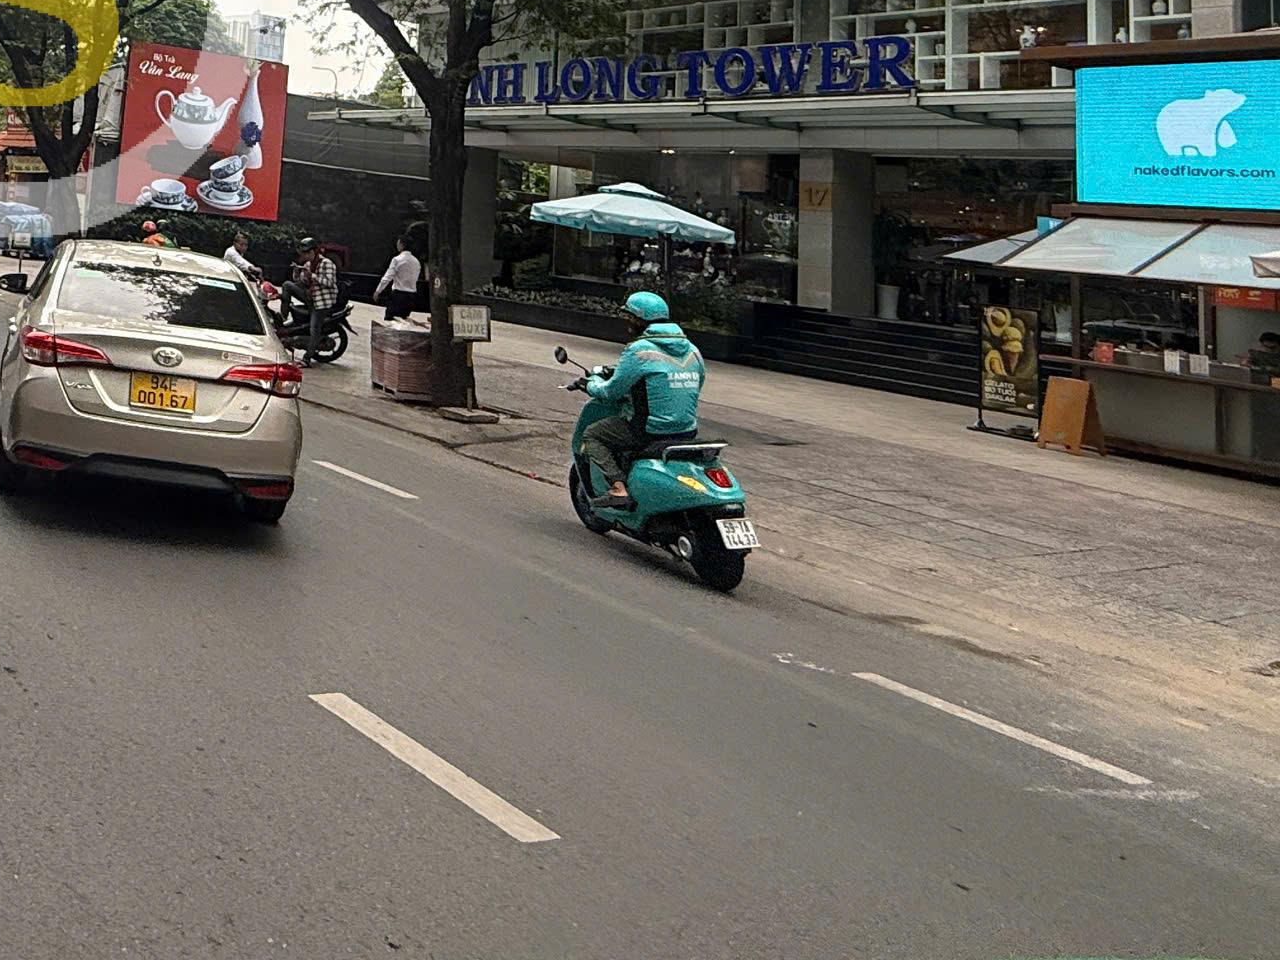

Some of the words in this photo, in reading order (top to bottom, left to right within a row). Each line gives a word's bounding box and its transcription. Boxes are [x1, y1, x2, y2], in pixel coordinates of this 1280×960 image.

[165, 65, 200, 84] Lang
[466, 63, 527, 106] NH
[534, 54, 665, 104] LONG
[676, 36, 918, 100] TOWER
[1133, 165, 1276, 178] nakedflavors.com
[804, 187, 829, 207] 17
[150, 376, 177, 393] 94E
[137, 390, 189, 409] 001.67
